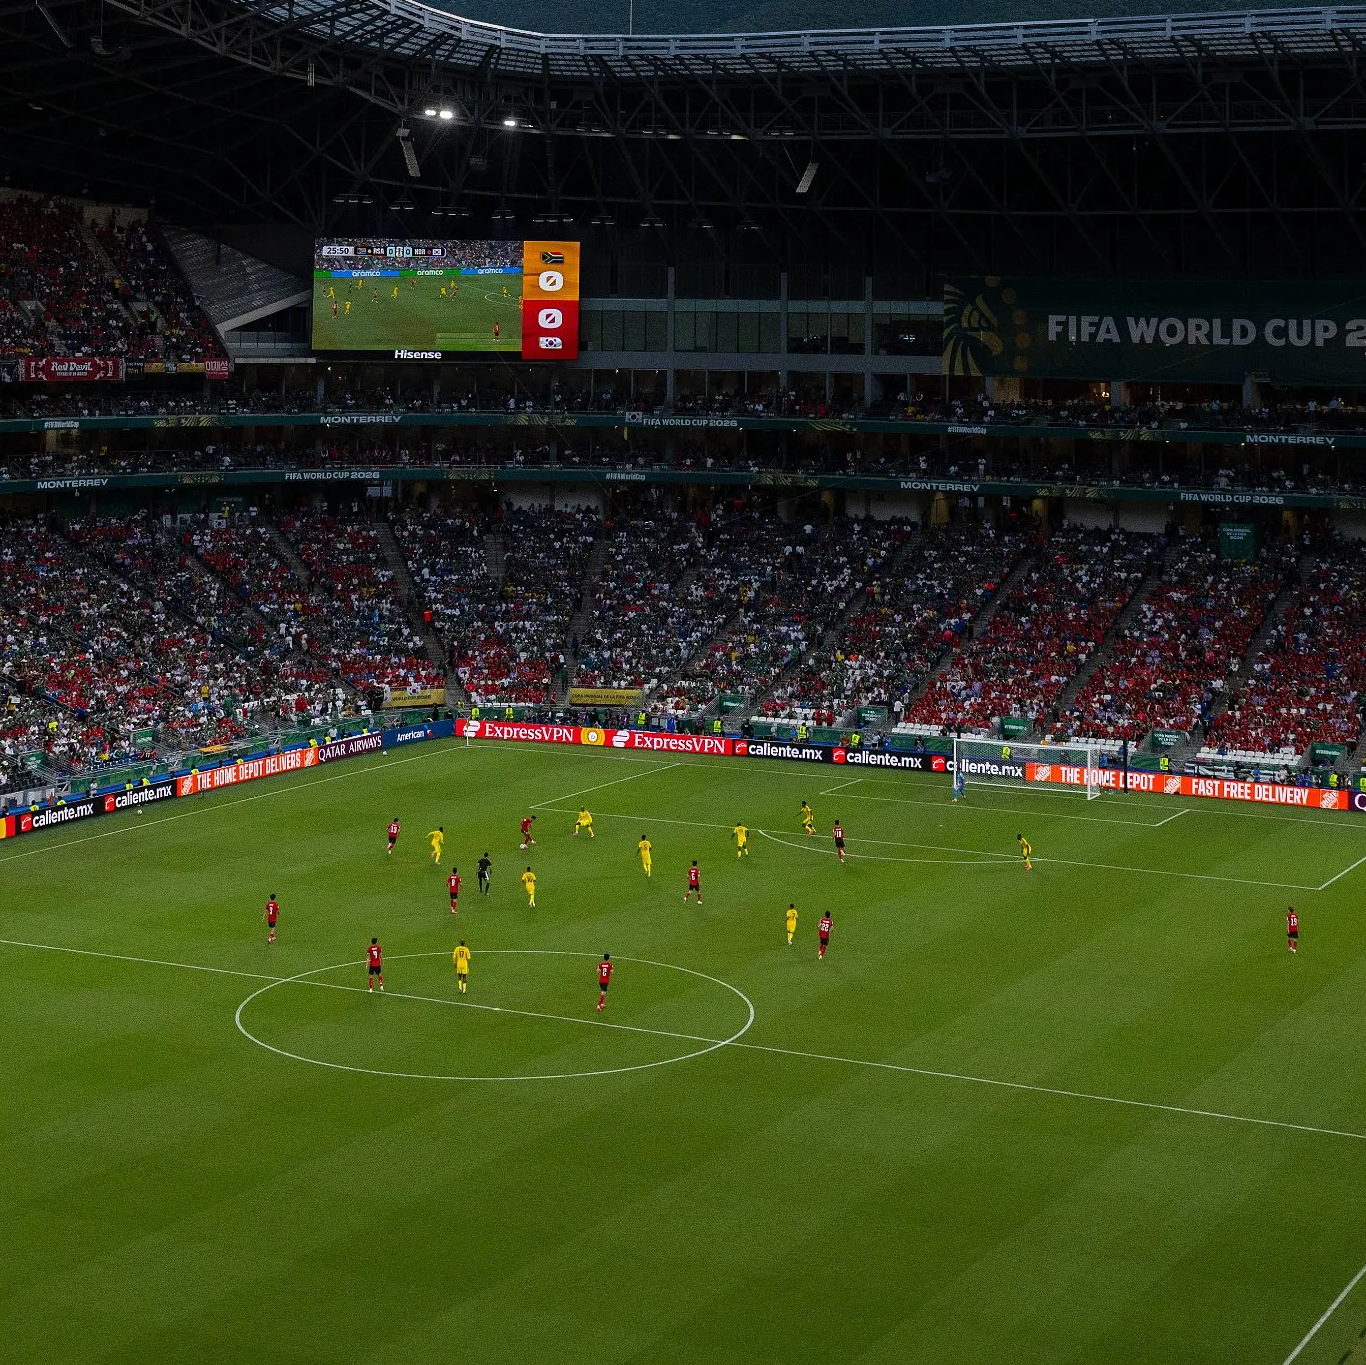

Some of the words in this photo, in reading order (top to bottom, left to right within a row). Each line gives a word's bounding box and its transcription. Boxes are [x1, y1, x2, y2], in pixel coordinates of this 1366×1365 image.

[326, 247, 350, 255] 25:50
[1047, 314, 1121, 344] FIFA
[1126, 317, 1257, 347] WORLD
[1263, 318, 1338, 347] CUP
[394, 349, 442, 360] Hisense
[320, 415, 402, 425] MONTERREY
[643, 418, 661, 426] FIFA
[661, 418, 691, 427] WORLD
[691, 418, 709, 427] CUP
[709, 418, 738, 427] 2026
[1246, 434, 1336, 445] MONTERREY
[37, 478, 109, 490] MONTERREY
[285, 472, 303, 480] FIFA
[303, 472, 332, 480] WORLD
[332, 472, 350, 480] CUP
[350, 471, 380, 479] 2026
[900, 481, 980, 492] MONTERREY
[1180, 492, 1199, 501] FIFA
[1199, 492, 1233, 502] WORLD
[1233, 494, 1252, 503] CUP
[1252, 495, 1285, 505] 2026
[396, 729, 425, 742] American
[484, 723, 575, 742] ExpressVPN
[318, 743, 346, 762] QATAR
[348, 735, 383, 755] AIRWAYS
[634, 732, 726, 754] ExpressVPN
[748, 742, 823, 761] caliente.mx
[846, 750, 923, 769] caliente.mx
[946, 759, 1023, 778] cliente.mx
[197, 773, 214, 791] THE
[214, 766, 238, 787] HOME
[239, 759, 265, 781] DEPOT
[265, 752, 302, 775] DELIVERS
[1060, 766, 1081, 784] THE
[115, 784, 173, 809] caliente.mx
[1191, 778, 1221, 797] FAST
[1223, 781, 1253, 800] FREE
[1254, 784, 1309, 805] DELIVERY
[32, 802, 94, 827] caliente.mx
